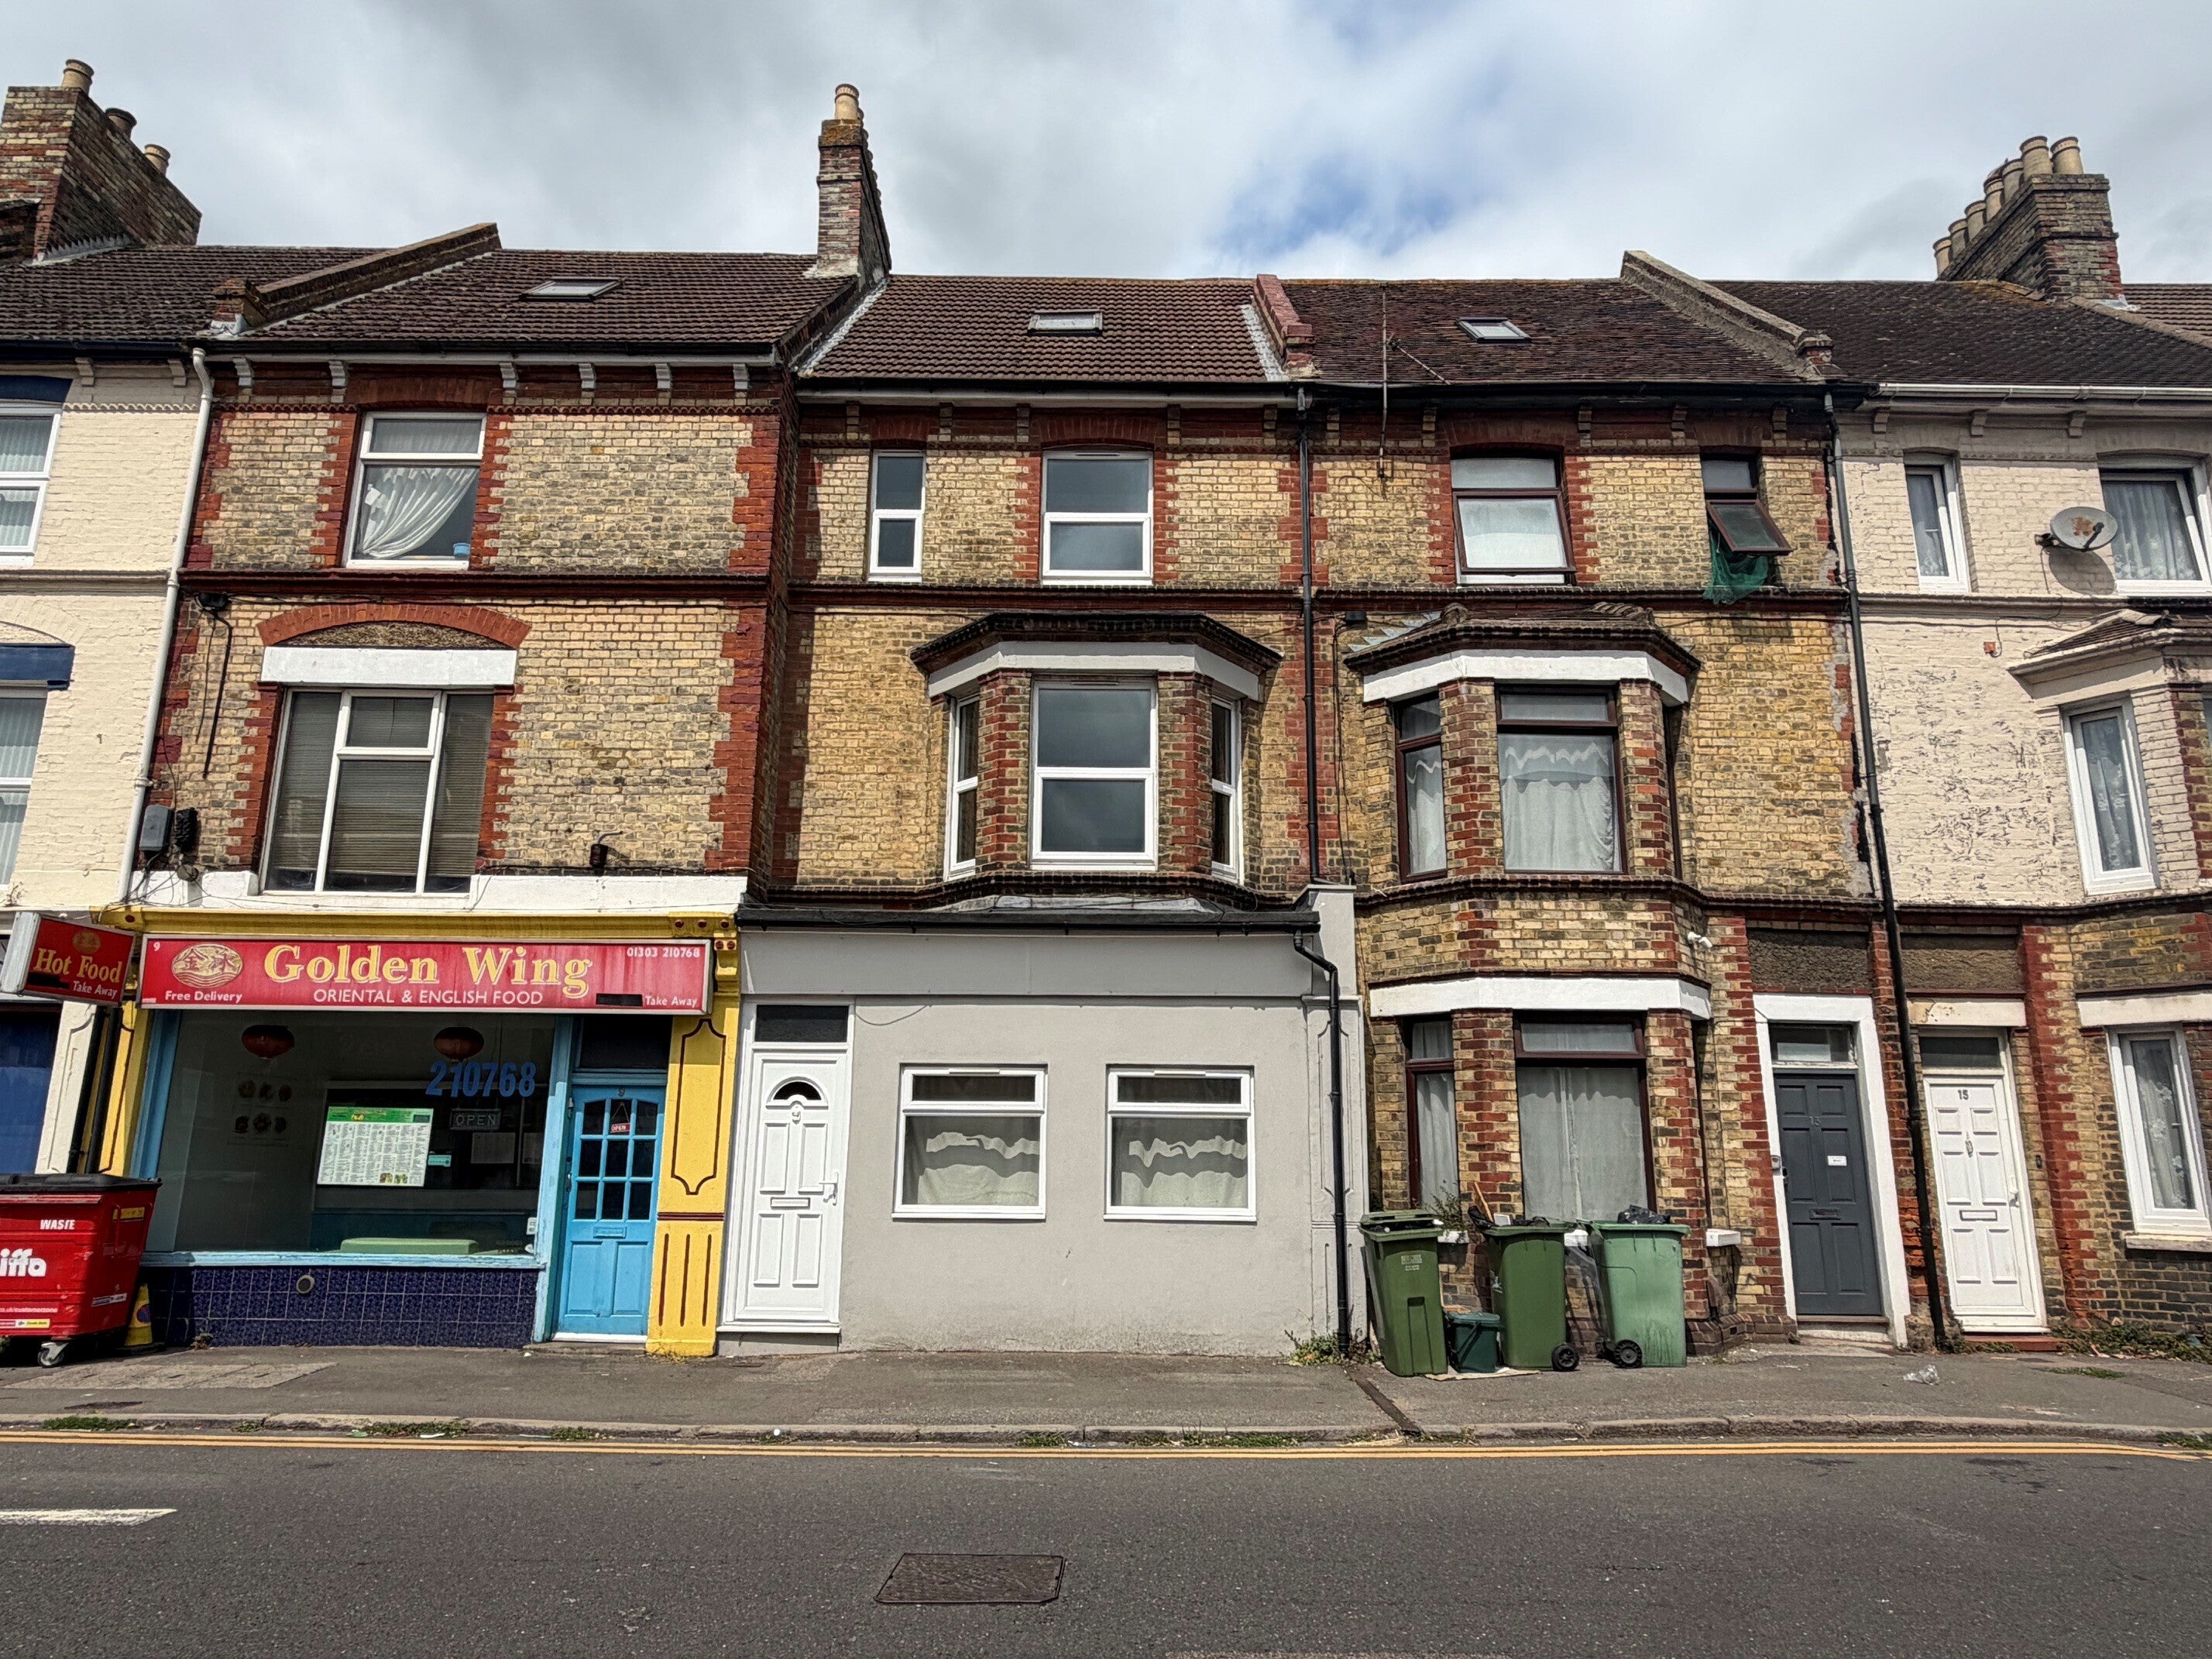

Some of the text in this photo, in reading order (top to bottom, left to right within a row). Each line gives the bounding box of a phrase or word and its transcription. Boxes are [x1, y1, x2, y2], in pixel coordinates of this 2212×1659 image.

[153, 941, 161, 951] 9
[627, 946, 701, 958] 01303 210768
[33, 947, 124, 984] Hot Food
[264, 944, 593, 999] Golden Wing
[73, 980, 118, 1000] Take Away
[164, 990, 191, 1001] Free
[194, 990, 243, 1004] Delivery
[314, 988, 544, 1005] ORIENTAL & ENGLISH FOOD
[644, 995, 698, 1008] Take Away
[425, 1060, 537, 1098] 210768
[1957, 1089, 1970, 1101] 15
[455, 1113, 496, 1127] OPEN
[40, 1219, 76, 1230] WASTE
